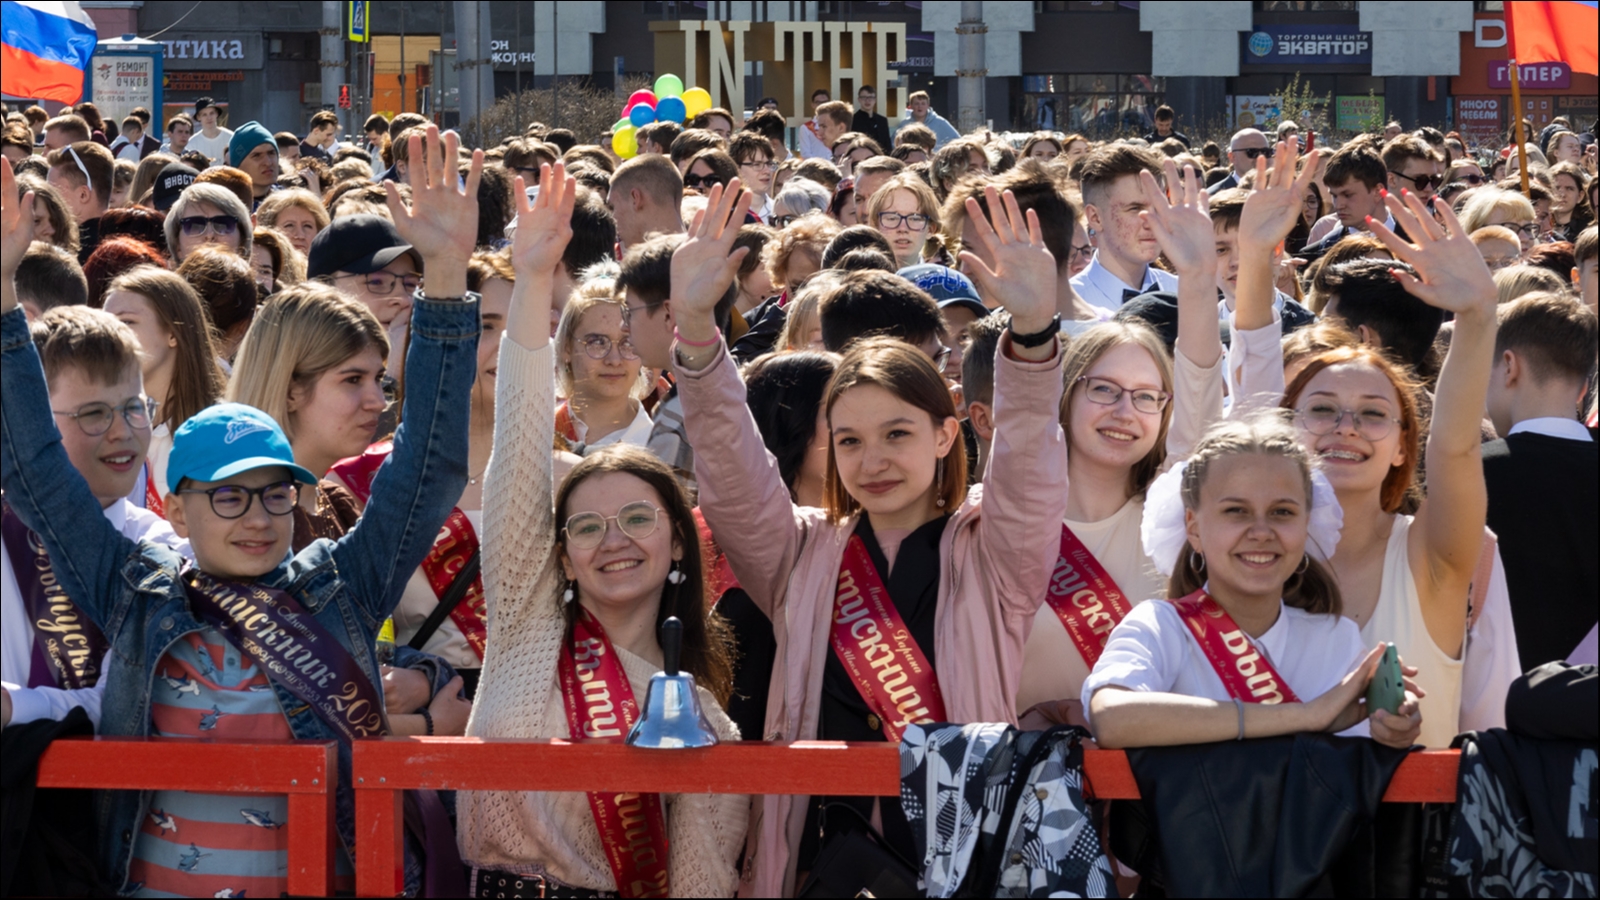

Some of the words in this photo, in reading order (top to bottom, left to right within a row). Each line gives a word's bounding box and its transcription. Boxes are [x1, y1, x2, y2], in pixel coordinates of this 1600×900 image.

[163, 40, 244, 59] птика
[1278, 41, 1368, 55] ЭКВАТОР
[116, 62, 149, 71] РЕМОНТ
[680, 20, 750, 122] IN
[774, 22, 906, 127] THE
[116, 77, 149, 87] ОЧКОВ
[1460, 100, 1498, 109] МНОГО
[1460, 110, 1498, 120] МЕБЕЛИ
[277, 606, 318, 643] Антон
[892, 629, 922, 674] Дарина
[327, 681, 389, 736] 202
